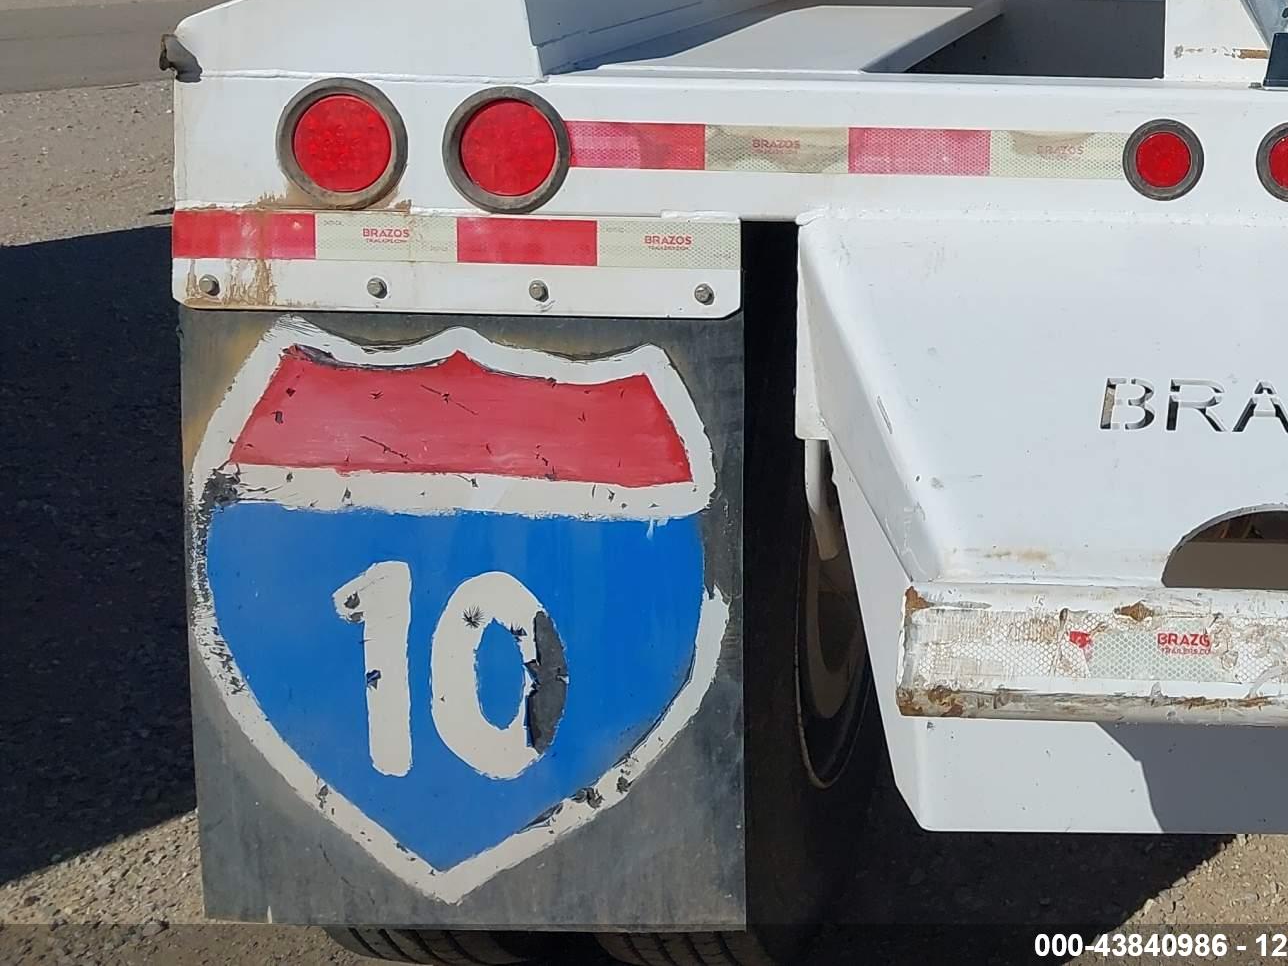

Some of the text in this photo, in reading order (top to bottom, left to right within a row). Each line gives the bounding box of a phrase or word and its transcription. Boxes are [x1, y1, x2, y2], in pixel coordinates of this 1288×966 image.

[362, 228, 410, 238] BRAZOS
[644, 235, 692, 245] BRAZOS
[331, 560, 568, 780] 10
